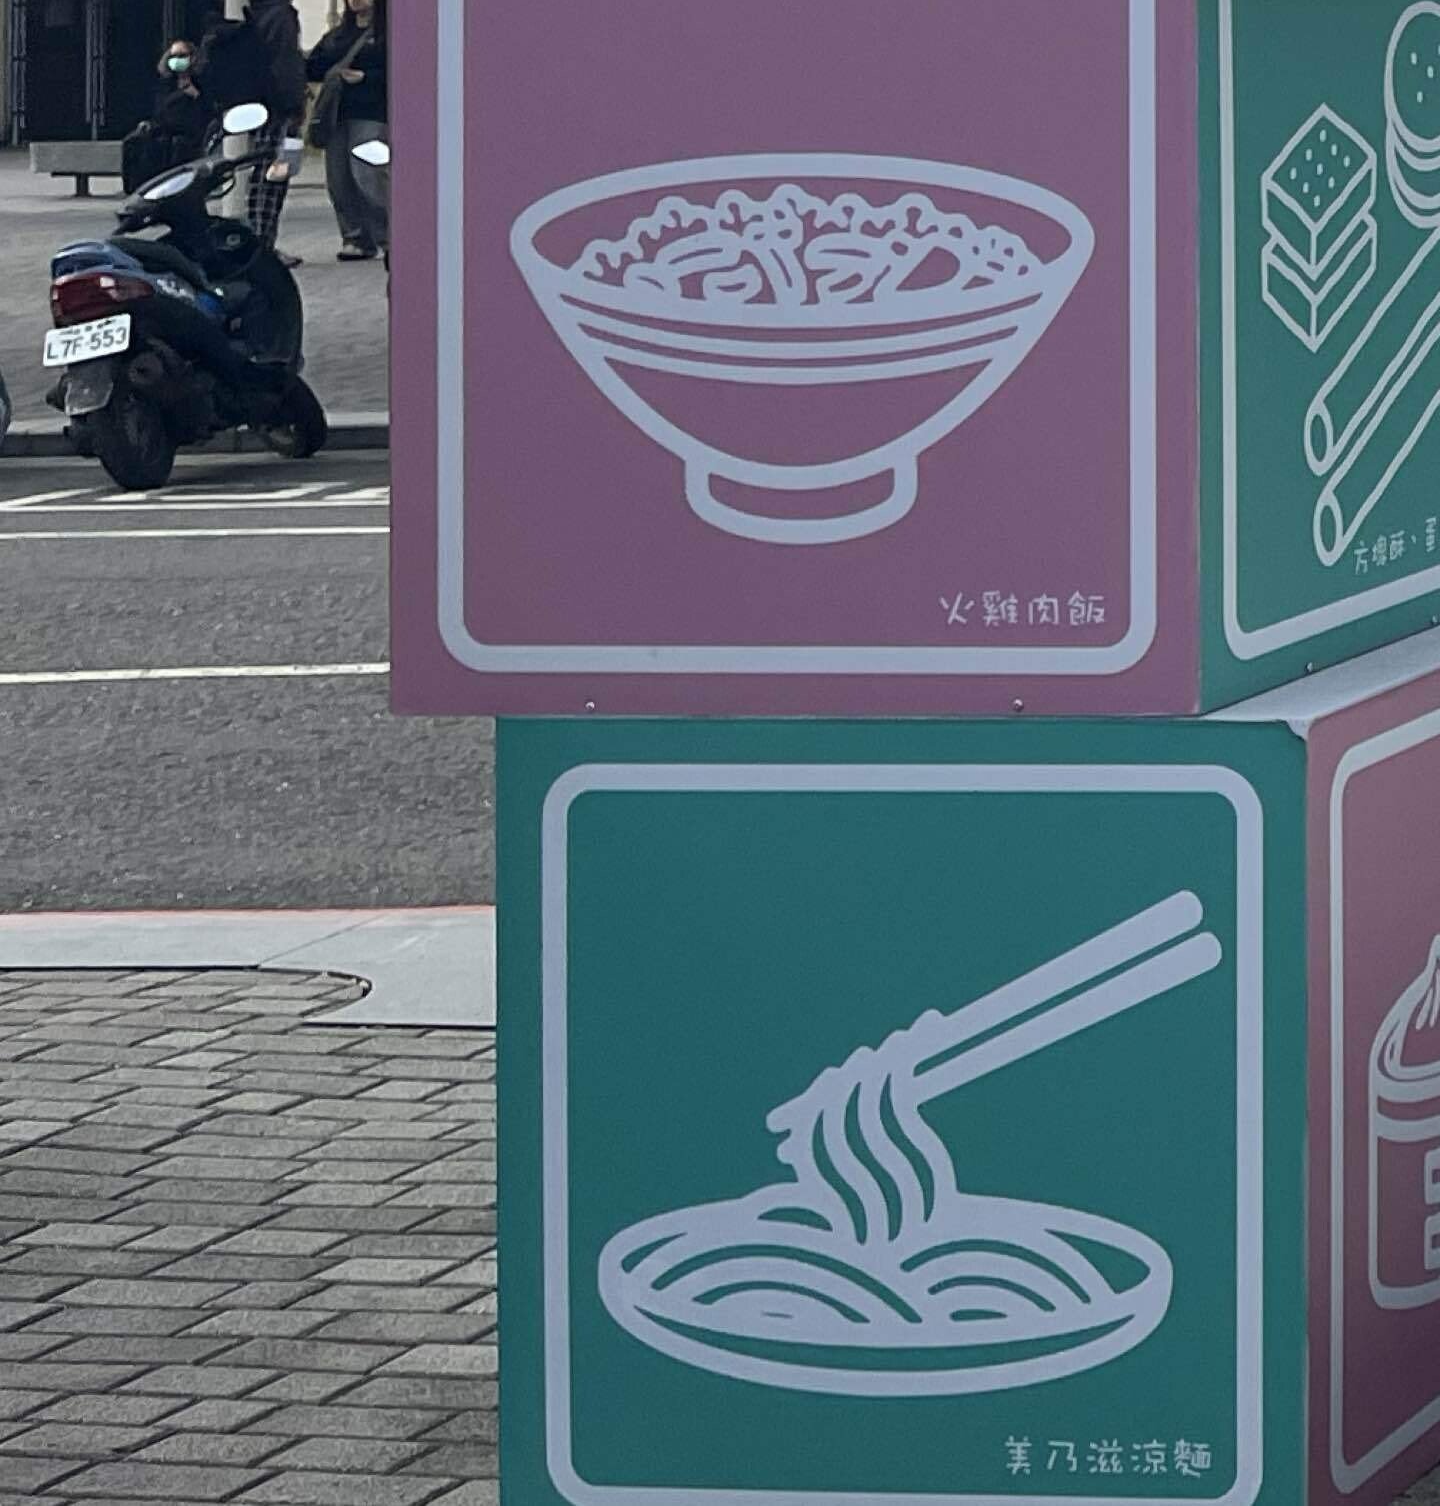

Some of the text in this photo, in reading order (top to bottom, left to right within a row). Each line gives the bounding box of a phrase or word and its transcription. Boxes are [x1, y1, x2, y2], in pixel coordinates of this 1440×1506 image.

[939, 590, 1105, 627] 火雞肉飯
[1004, 1435, 1212, 1478] 美乃滋涼麵
